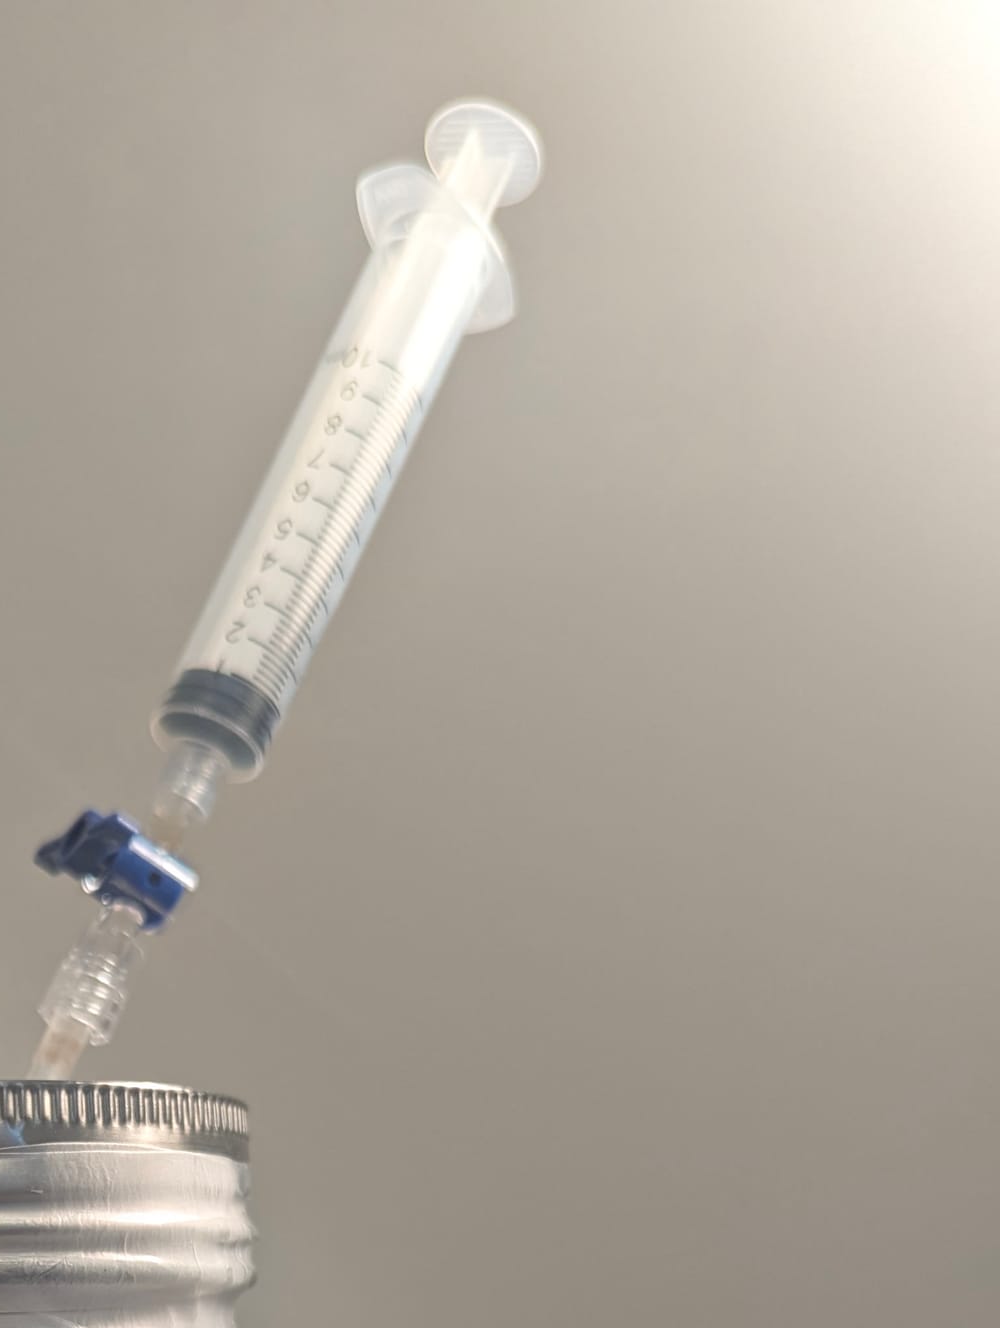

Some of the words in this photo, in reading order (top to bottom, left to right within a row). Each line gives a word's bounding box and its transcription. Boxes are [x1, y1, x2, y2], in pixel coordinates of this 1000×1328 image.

[324, 413, 342, 436] 8
[307, 449, 326, 469] 7
[292, 480, 310, 503] 6
[274, 518, 294, 541] 5
[259, 552, 277, 573] 4
[243, 585, 262, 608] 3
[225, 621, 246, 645] 2
